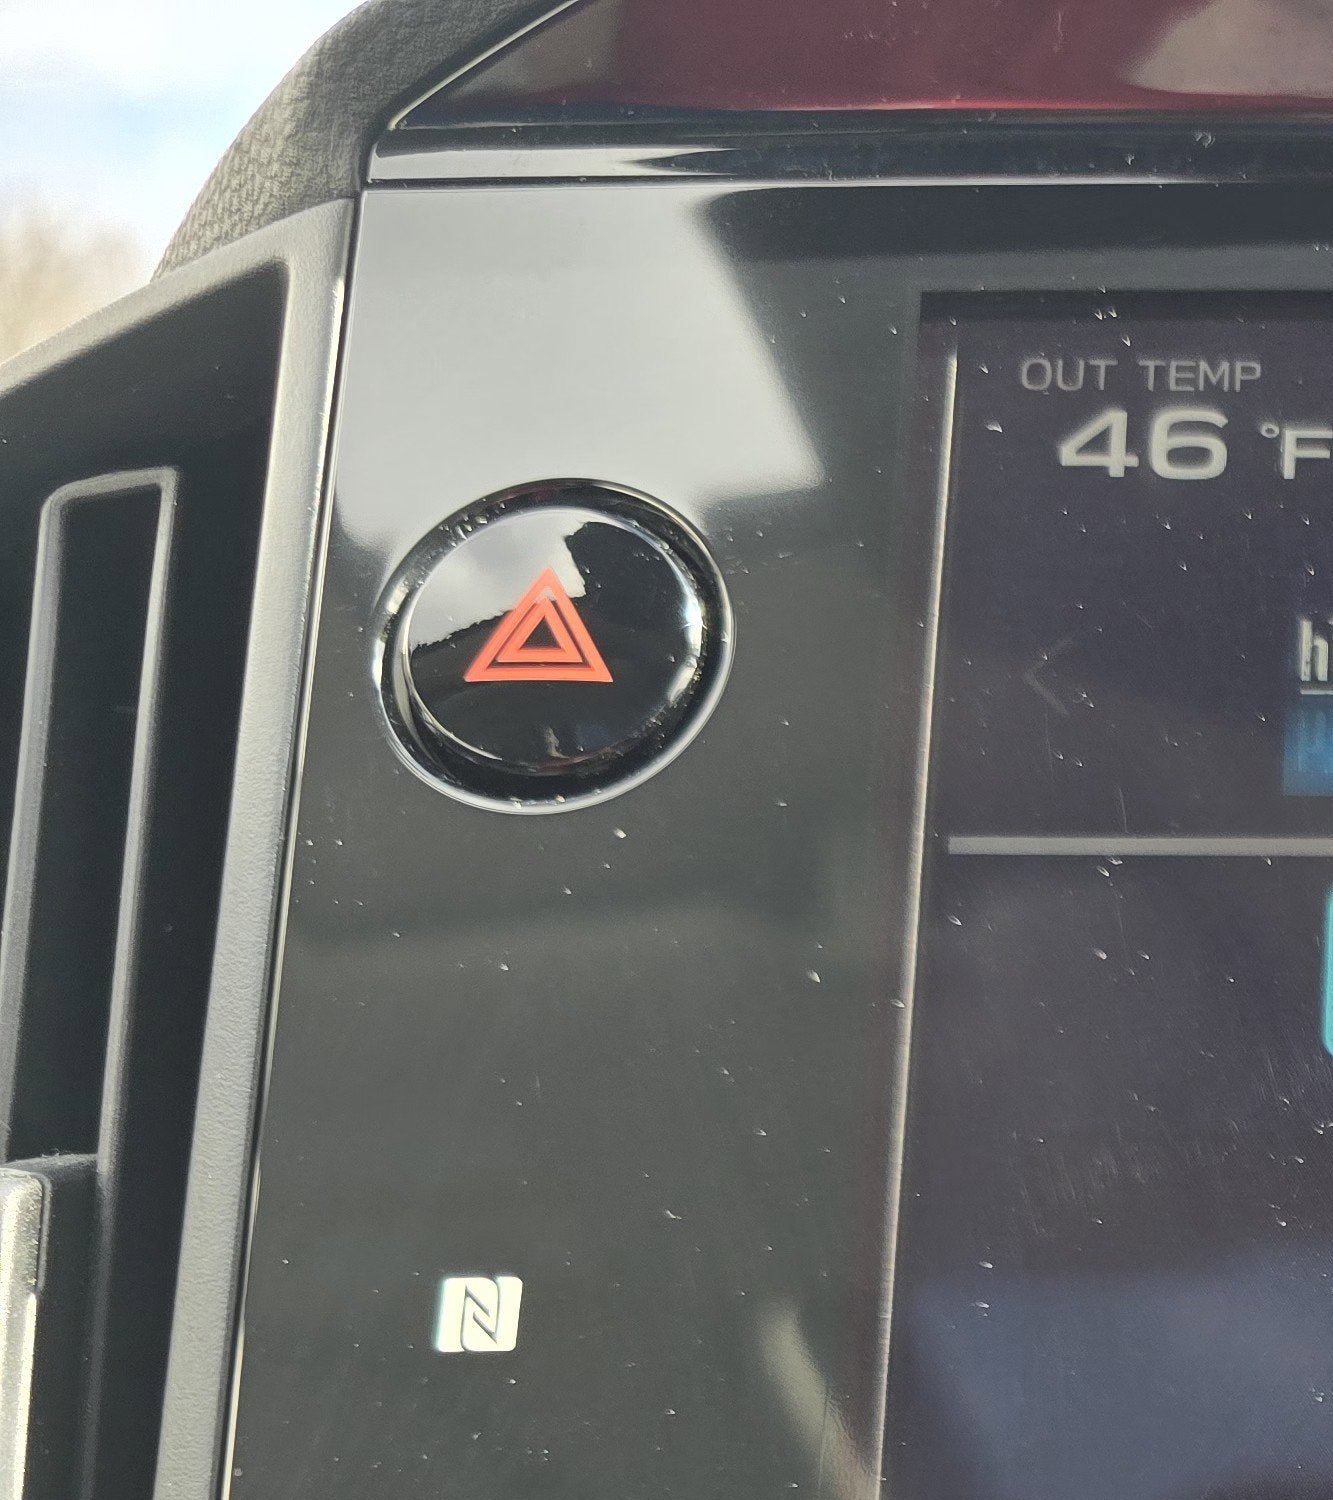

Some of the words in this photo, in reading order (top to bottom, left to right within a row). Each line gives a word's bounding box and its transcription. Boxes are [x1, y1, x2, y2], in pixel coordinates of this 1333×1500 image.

[1020, 359, 1117, 392] OUT
[1138, 360, 1262, 393] TEMP
[1058, 407, 1228, 480] 46
